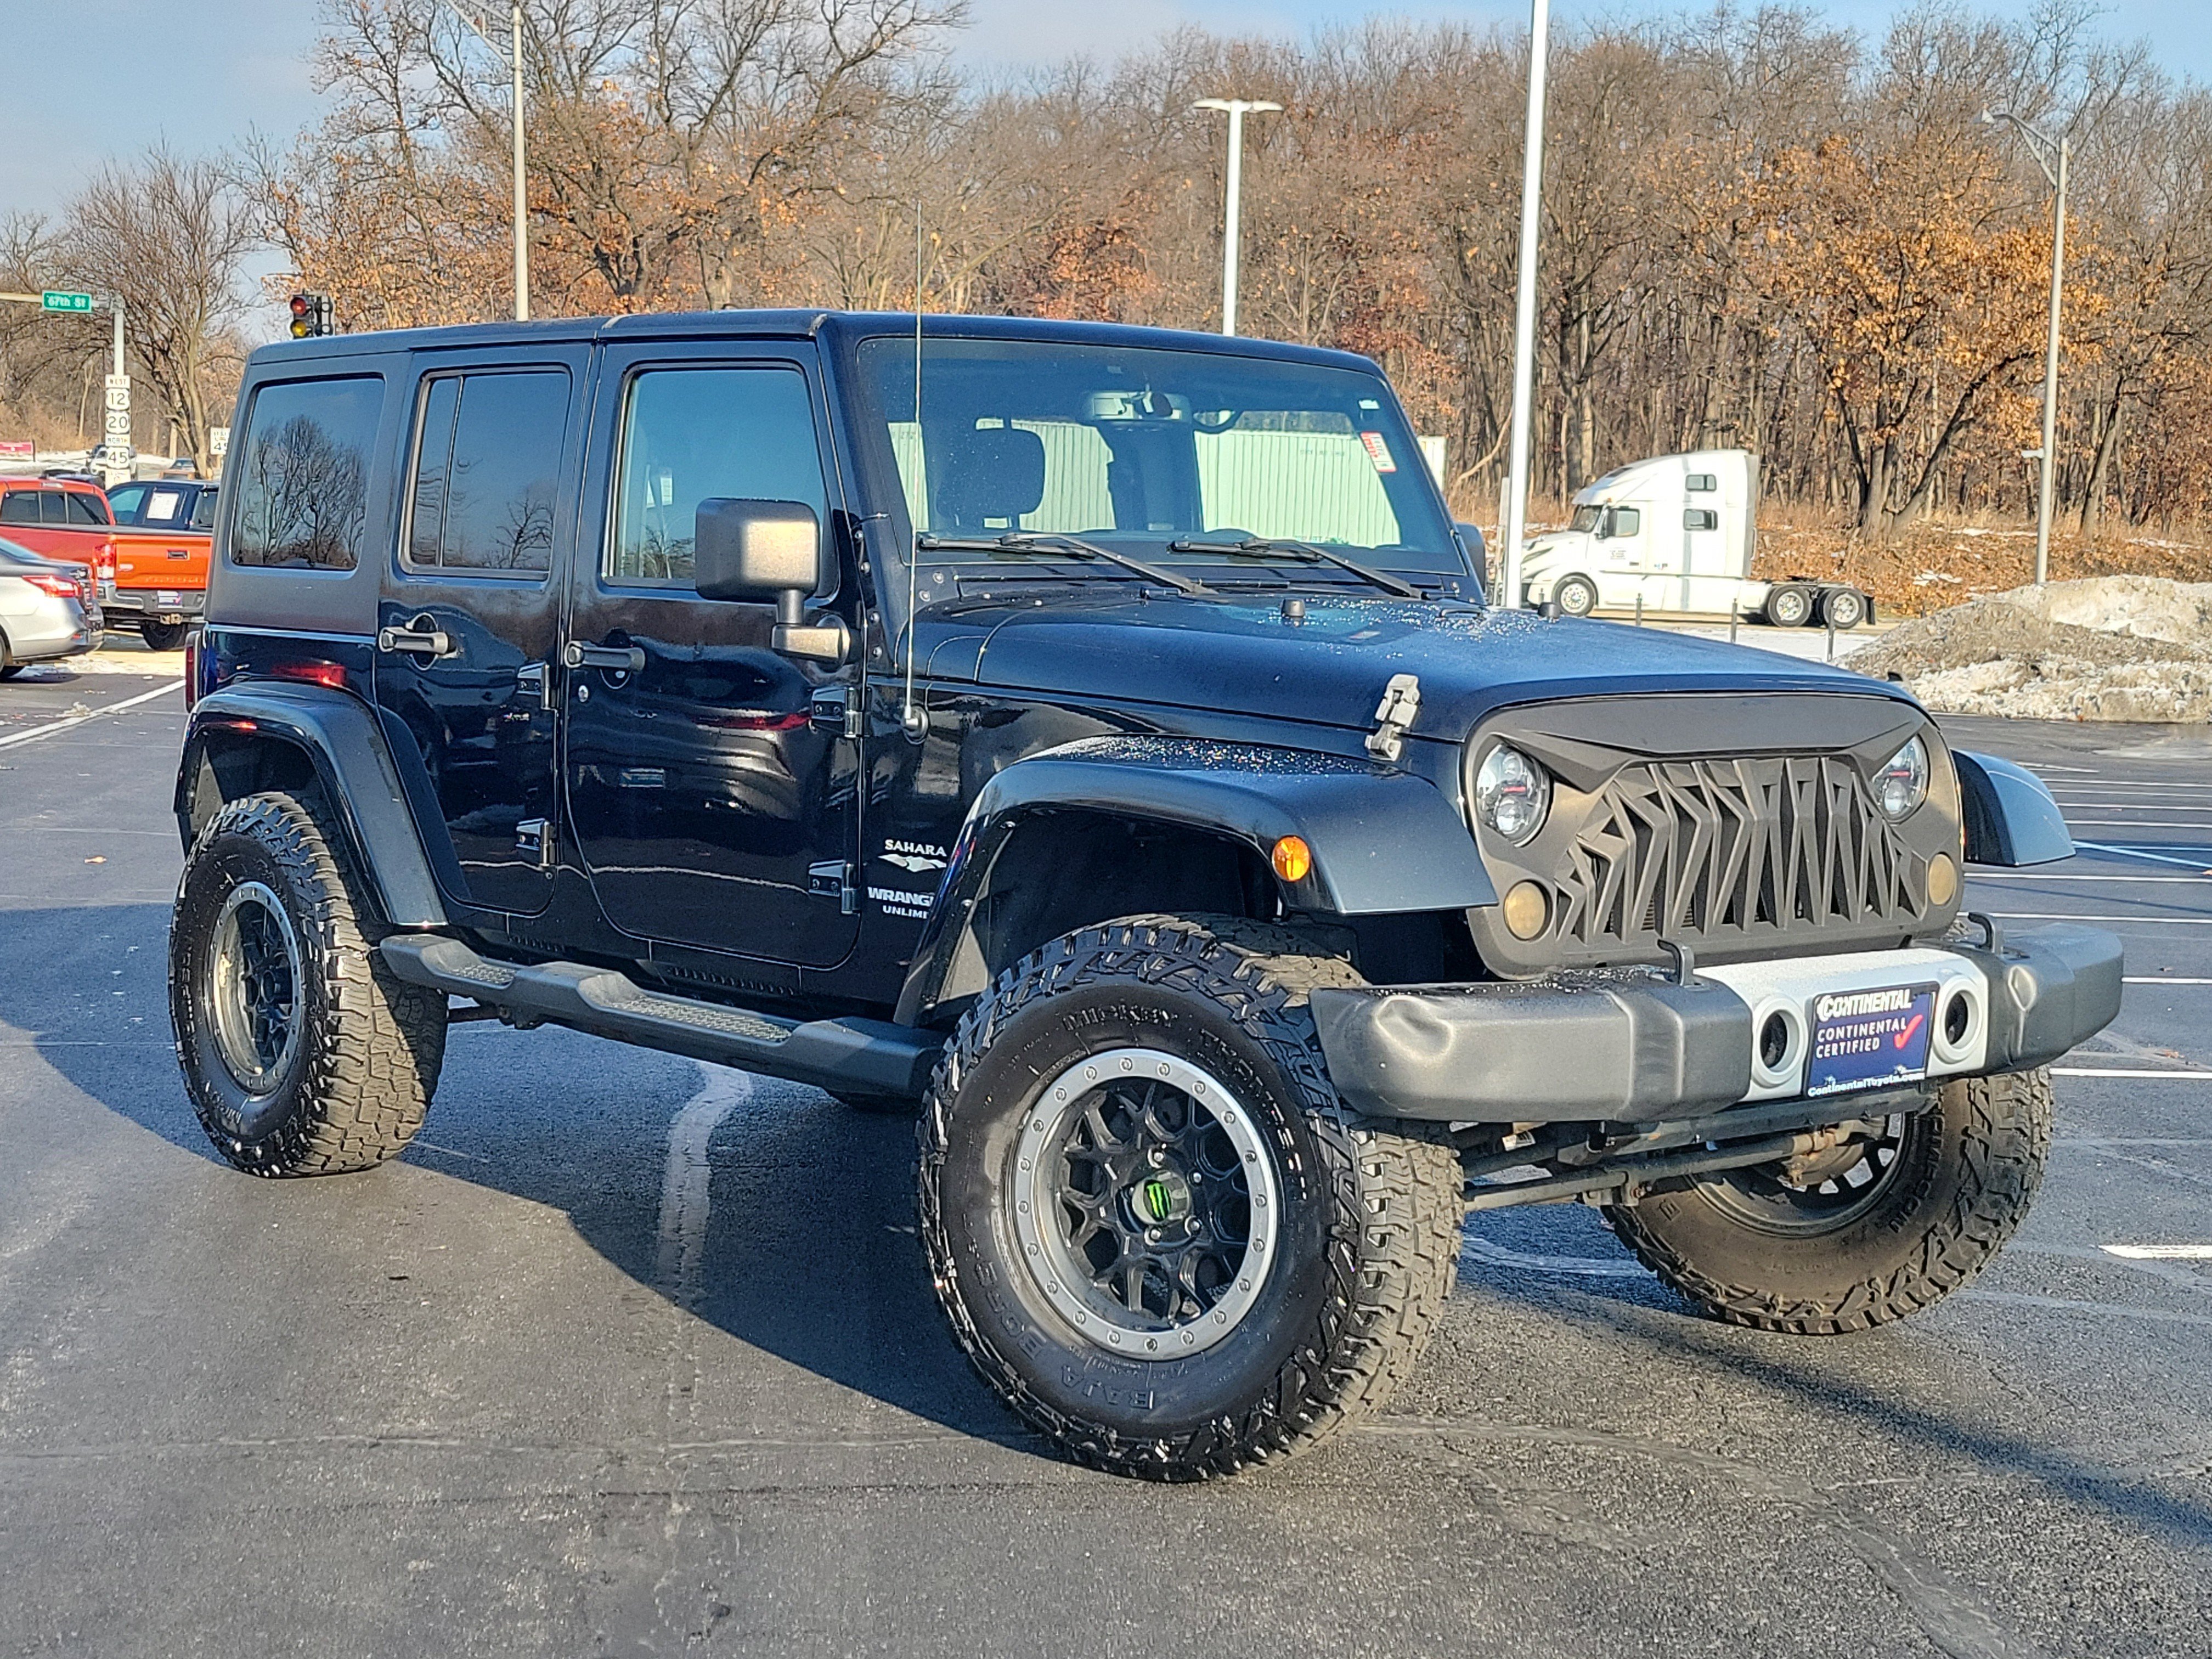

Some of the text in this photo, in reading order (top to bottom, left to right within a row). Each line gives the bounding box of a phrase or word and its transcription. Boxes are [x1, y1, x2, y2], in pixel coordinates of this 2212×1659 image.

[74, 296, 86, 308] St
[111, 392, 126, 405] 12
[109, 416, 128, 428] 20
[108, 451, 128, 464] 45
[884, 839, 947, 857] SAHARA
[882, 905, 929, 919] UNLIMI
[1816, 988, 1912, 1022] CONTINENTAL
[1817, 1017, 1906, 1042] CONTINENTAL
[1815, 1037, 1880, 1059] CERTIFIED
